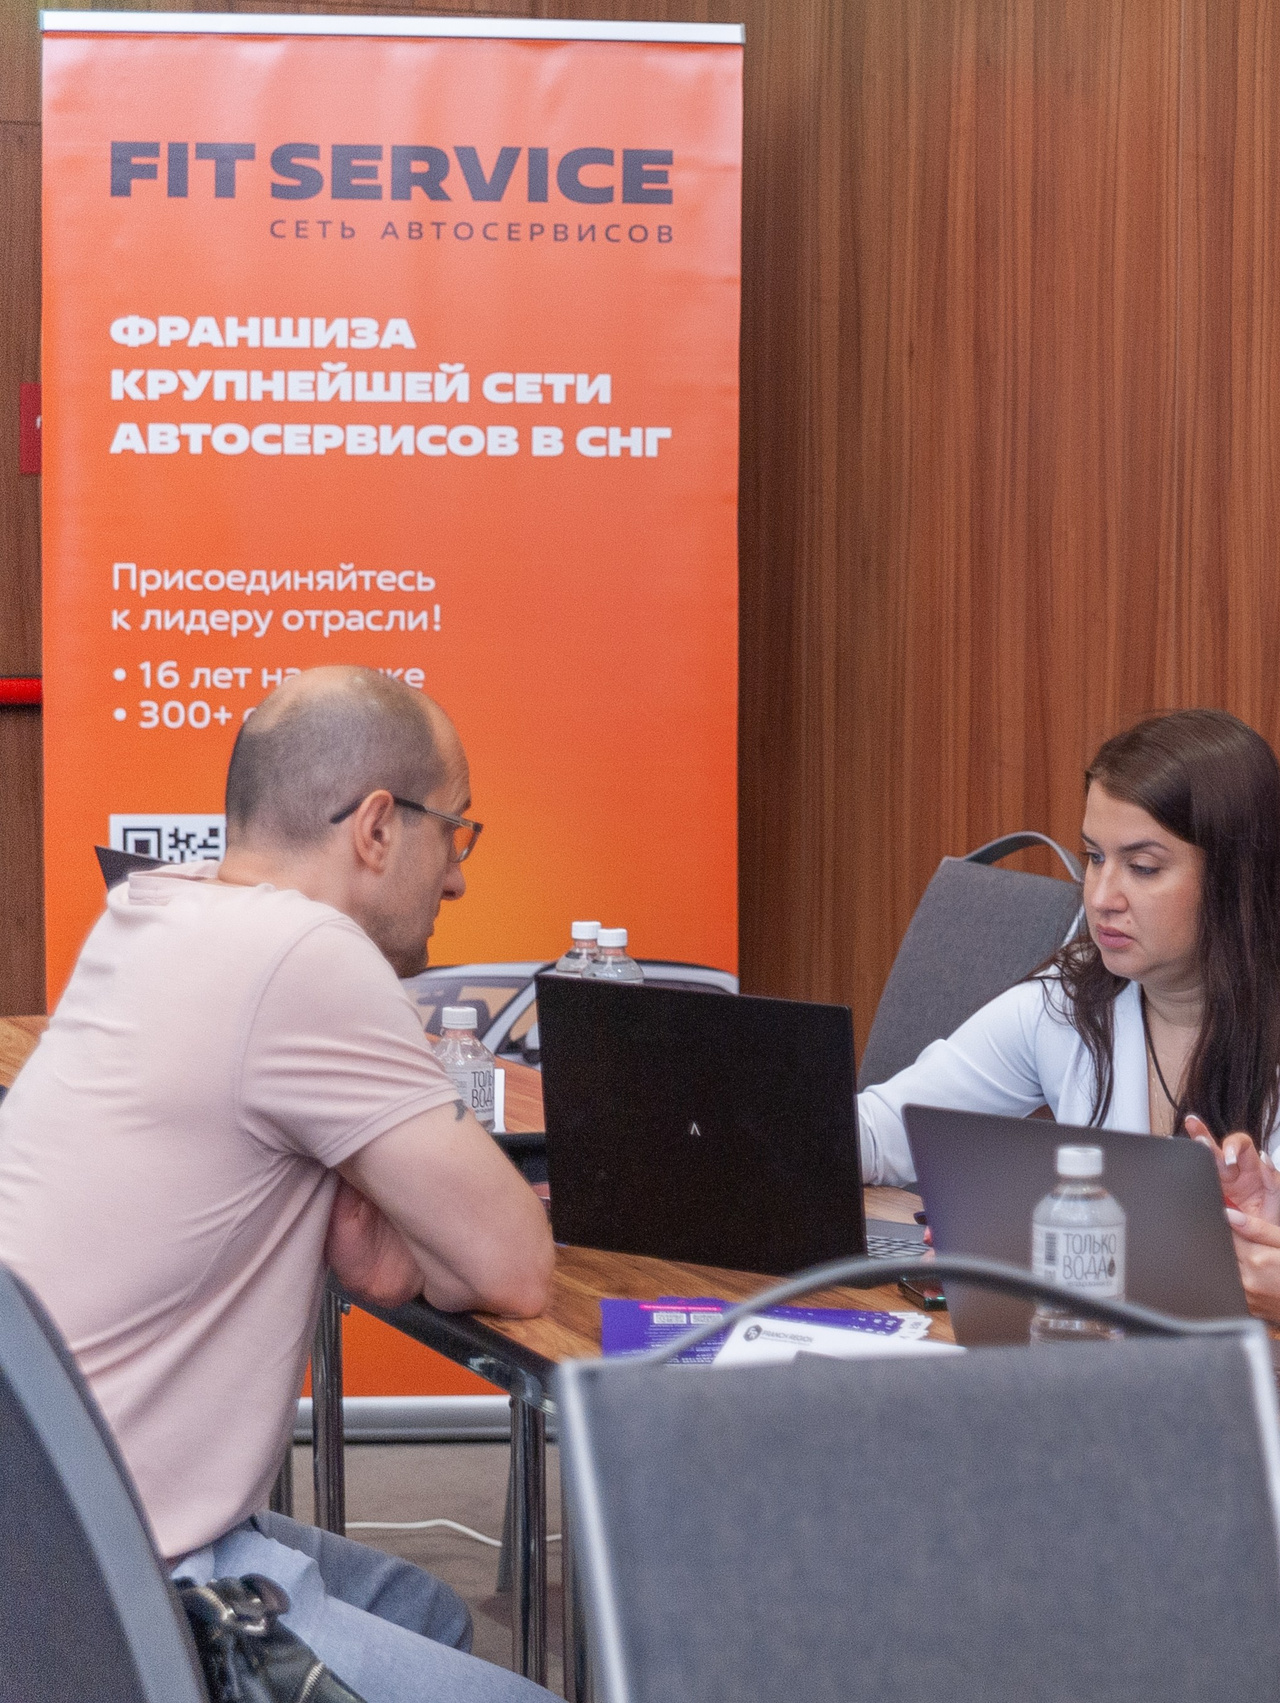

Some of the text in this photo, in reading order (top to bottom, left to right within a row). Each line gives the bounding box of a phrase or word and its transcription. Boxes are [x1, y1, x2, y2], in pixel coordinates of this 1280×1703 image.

[110, 141, 674, 205] FIT SERVICE
[269, 219, 674, 244] СЕТЬ АВТОСЕРВИСОВ
[109, 314, 417, 349] ФРАНШИЗА
[110, 361, 612, 404] КРУПНЕЙШЕЙ СЕТИ
[109, 422, 672, 458] АВТОСЕРВИСОВ В СНГ
[112, 562, 436, 597] Присоединяйтесь
[111, 604, 442, 638] к лидеру отрасли!
[139, 660, 302, 689] 16 лет на
[139, 700, 233, 729] 300+
[1063, 1233, 1117, 1255] ТОЛЬКО
[1062, 1255, 1108, 1280] ВОДА
